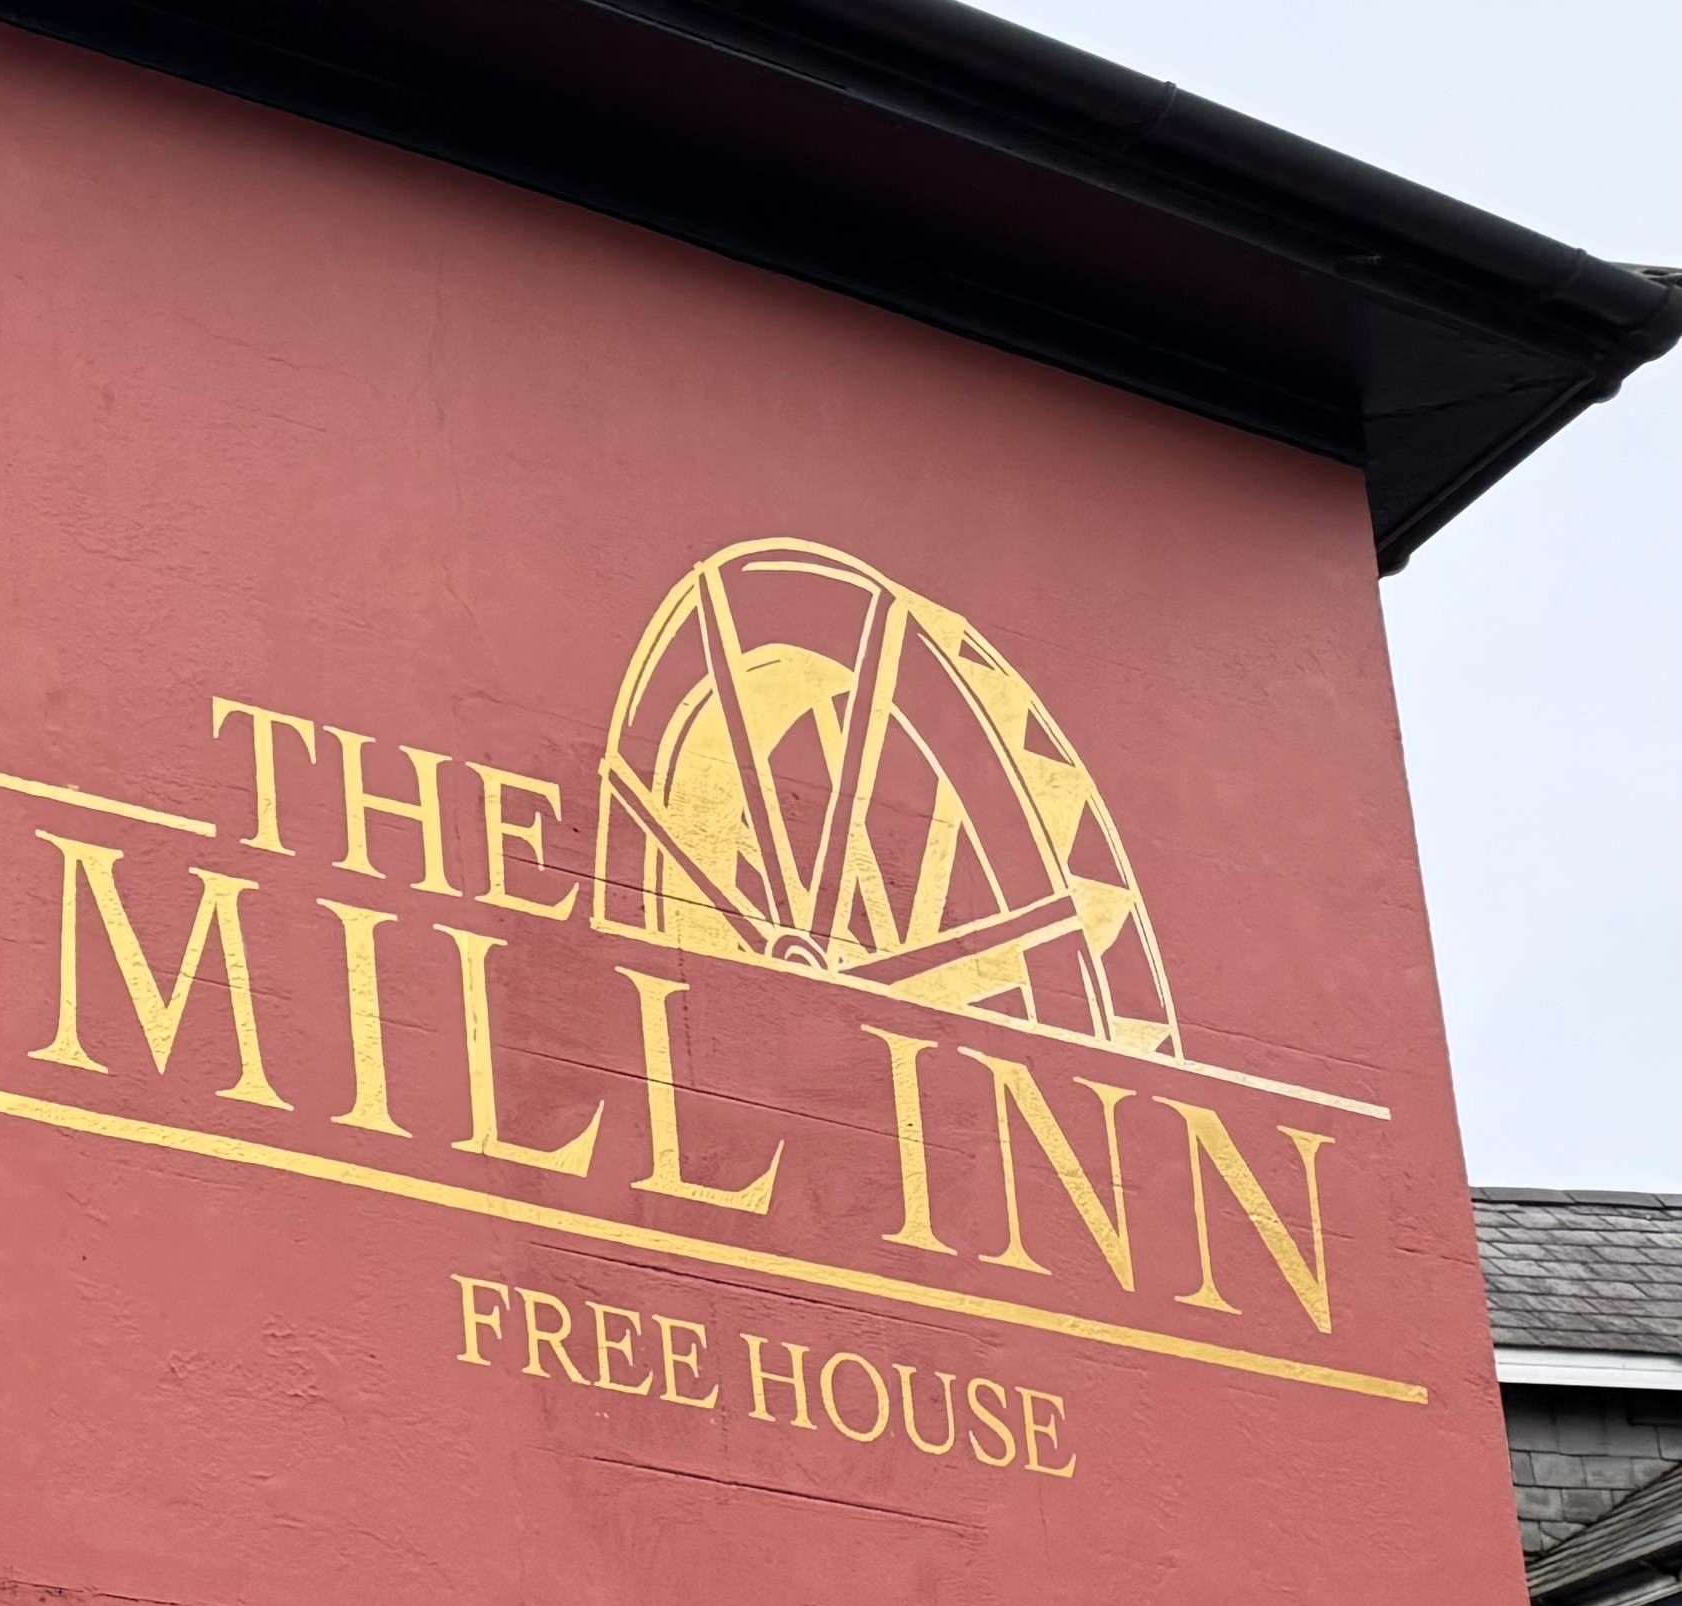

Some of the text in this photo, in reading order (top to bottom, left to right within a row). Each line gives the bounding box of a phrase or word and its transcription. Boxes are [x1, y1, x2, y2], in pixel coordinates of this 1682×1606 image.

[212, 696, 579, 923] THE
[27, 828, 1335, 1335] MILL INN
[452, 1274, 1078, 1480] FREE HOUSE
